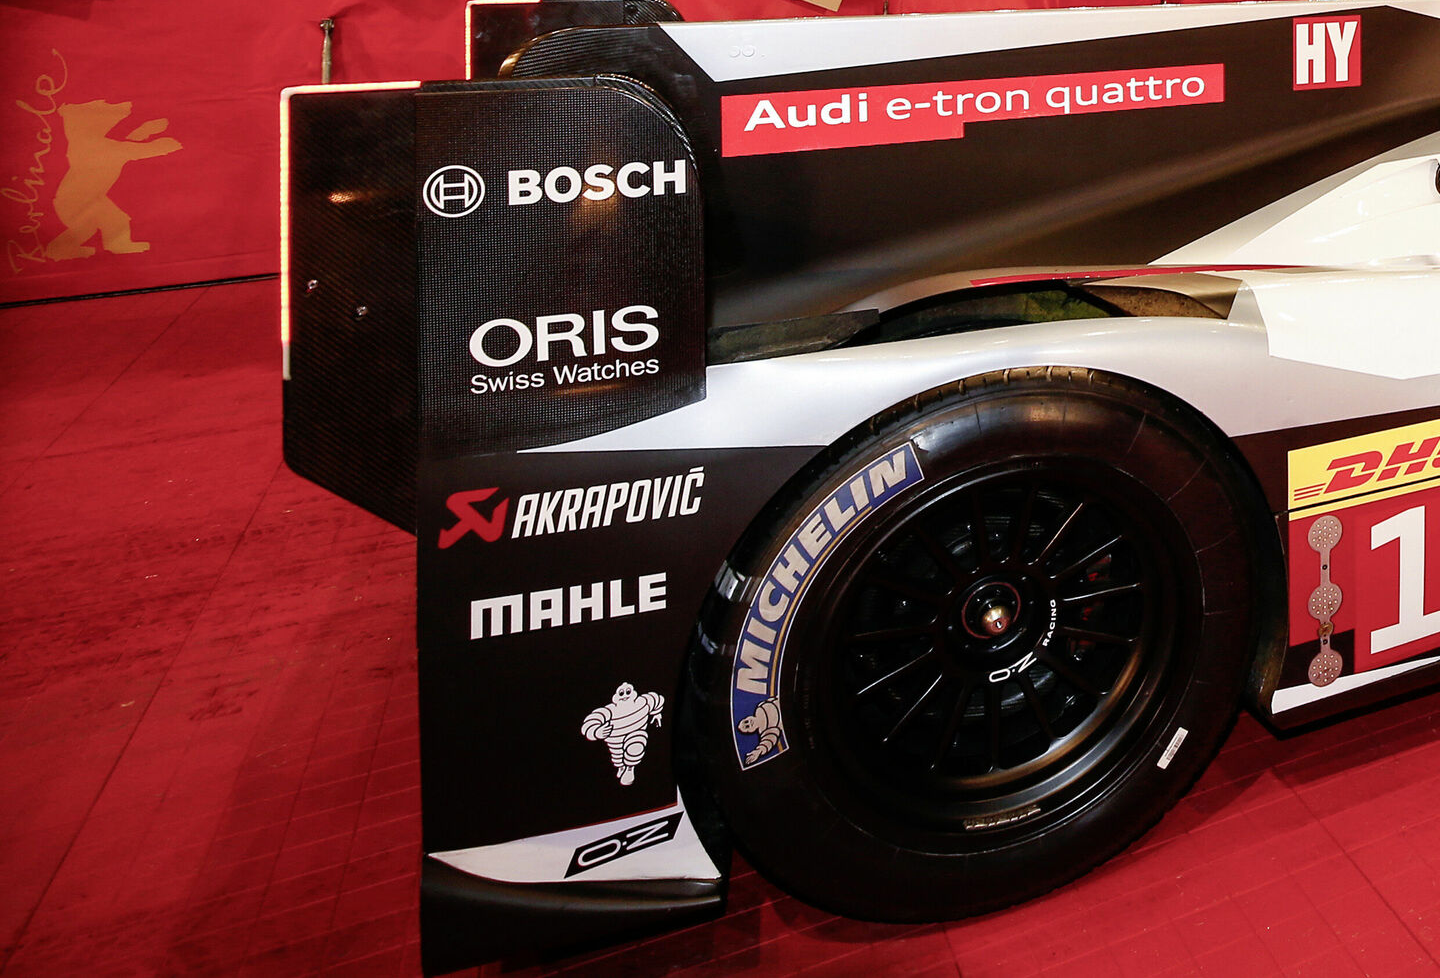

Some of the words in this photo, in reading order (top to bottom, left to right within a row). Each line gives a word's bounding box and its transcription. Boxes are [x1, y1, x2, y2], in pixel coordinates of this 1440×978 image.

[1295, 21, 1357, 85] HY
[744, 93, 868, 132] Audi
[886, 84, 1030, 121] e-tron
[1045, 75, 1205, 115] quattro
[1, 48, 68, 273] Berlinale
[508, 159, 687, 206] BOSCH
[469, 304, 660, 368] ORIS
[470, 371, 545, 395] Swiss
[552, 358, 660, 386] Watches
[511, 465, 705, 540] AKRAPOVIČ
[736, 450, 907, 695] MICHELIN
[470, 571, 667, 640] MAHLE
[1042, 599, 1057, 647] RACING
